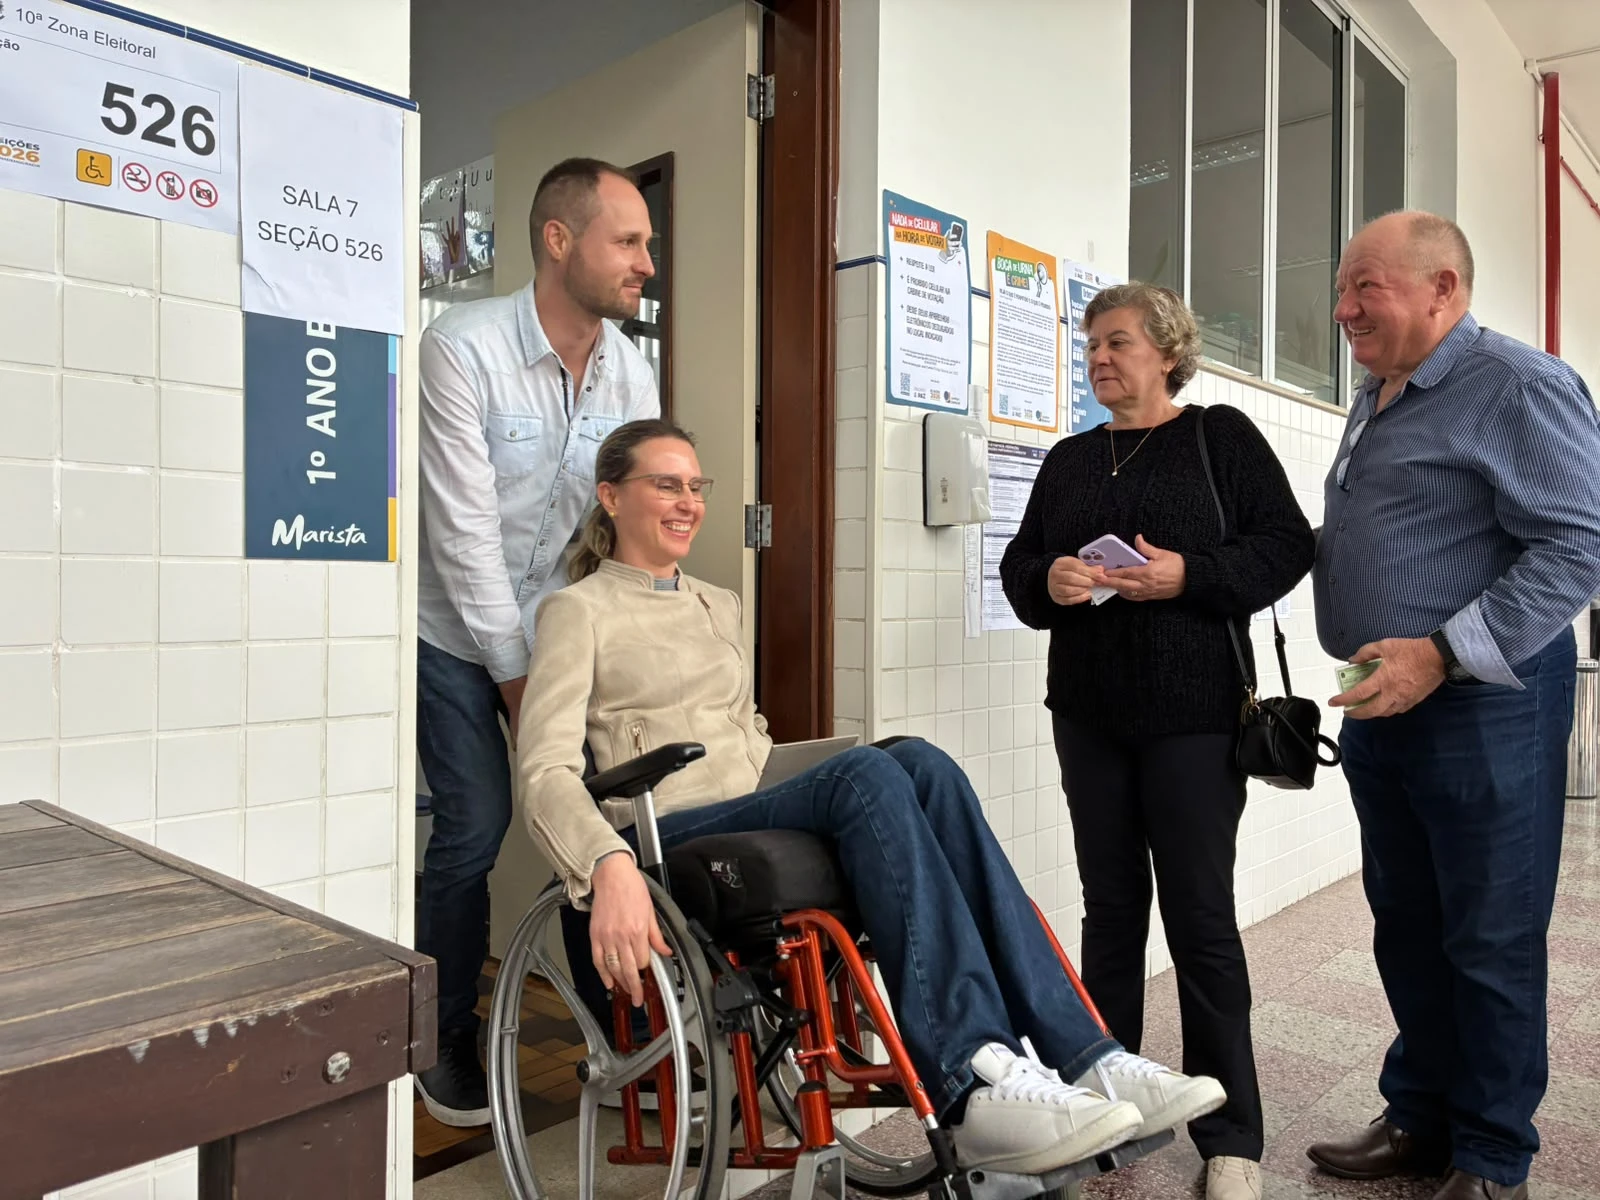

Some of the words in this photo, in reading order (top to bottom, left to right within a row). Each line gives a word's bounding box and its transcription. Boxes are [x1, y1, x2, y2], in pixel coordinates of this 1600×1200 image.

[16, 8, 42, 24] 10ª
[47, 16, 89, 40] Zona
[94, 30, 156, 59] Eleitoral
[100, 81, 215, 156] 526
[283, 185, 341, 215] SALA
[346, 199, 358, 217] 7
[258, 220, 339, 252] SEÇÃO
[345, 238, 383, 261] 526
[892, 213, 907, 227] NADA
[913, 217, 938, 233] CELULAR
[902, 231, 920, 243] HORA
[997, 257, 1012, 271] BOCA
[305, 347, 337, 438] ANO
[272, 514, 367, 550] Marista
